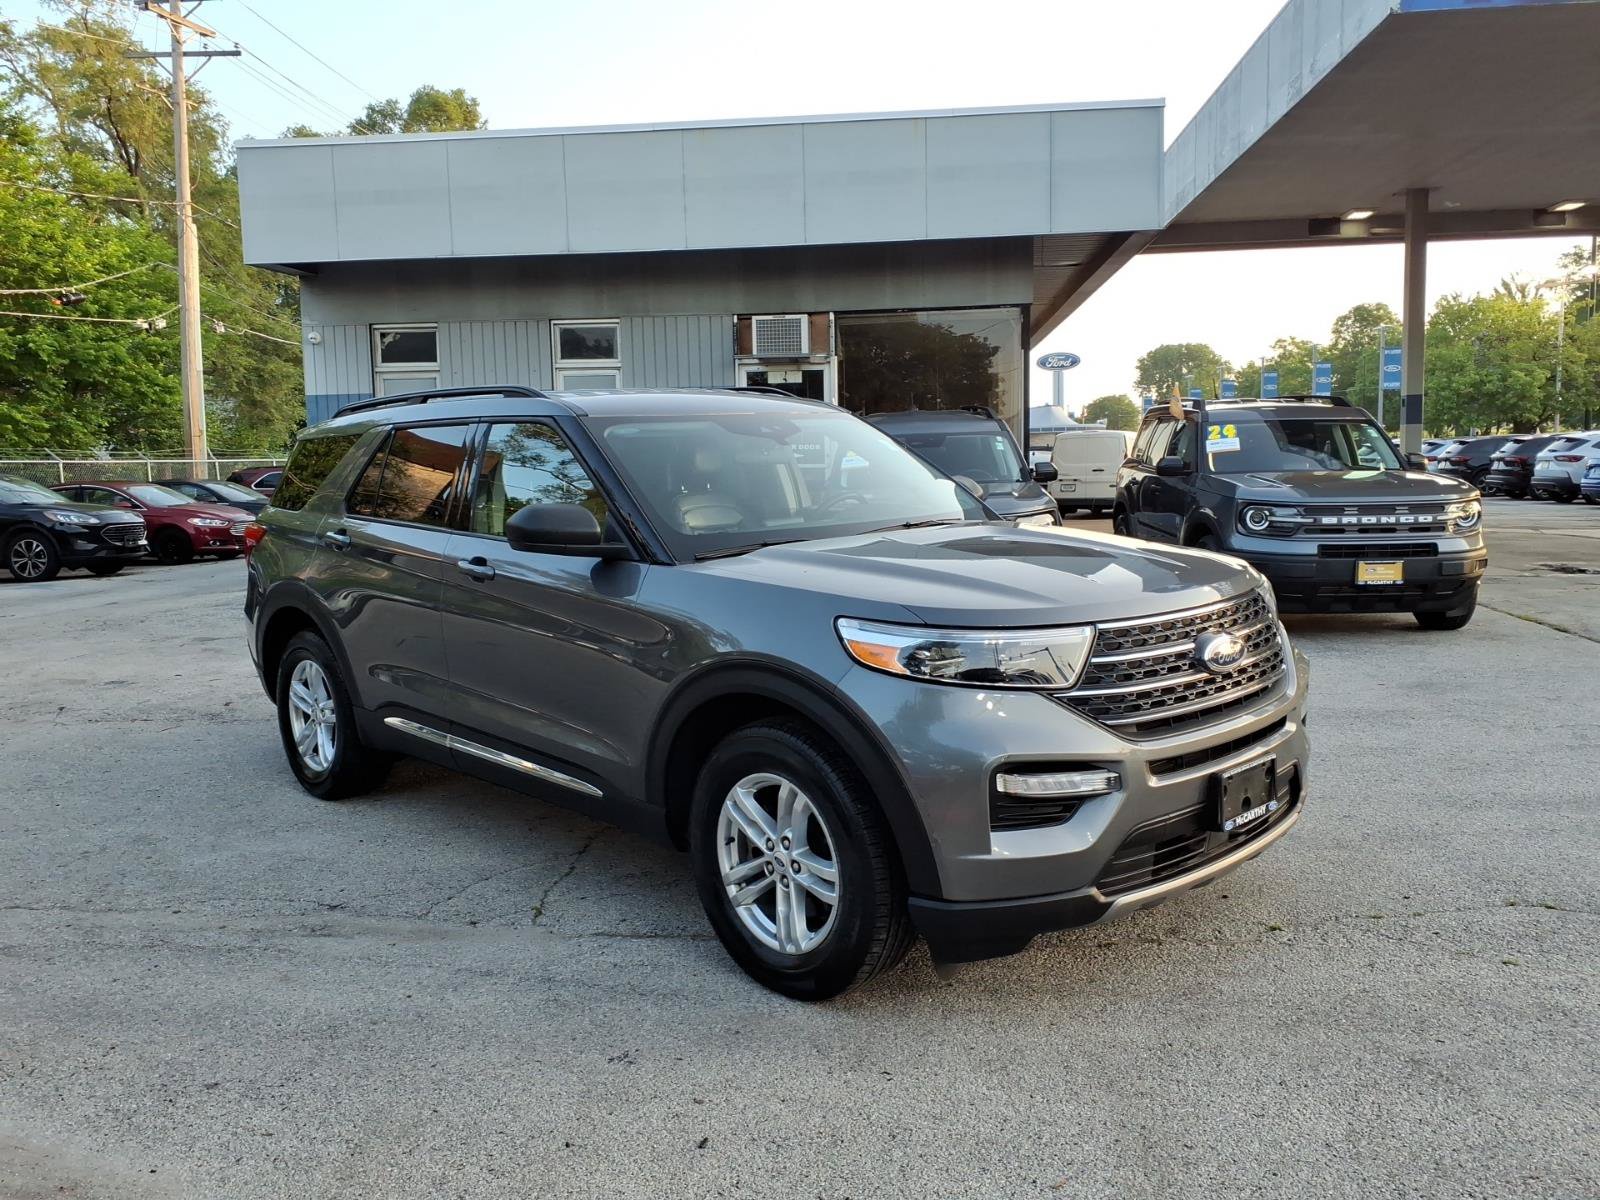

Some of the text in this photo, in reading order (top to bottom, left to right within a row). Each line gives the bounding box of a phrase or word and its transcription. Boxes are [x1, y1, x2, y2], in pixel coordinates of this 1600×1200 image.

[1045, 355, 1072, 368] Ford
[1321, 515, 1433, 524] BRONCO
[1236, 803, 1267, 827] McCARTHY
